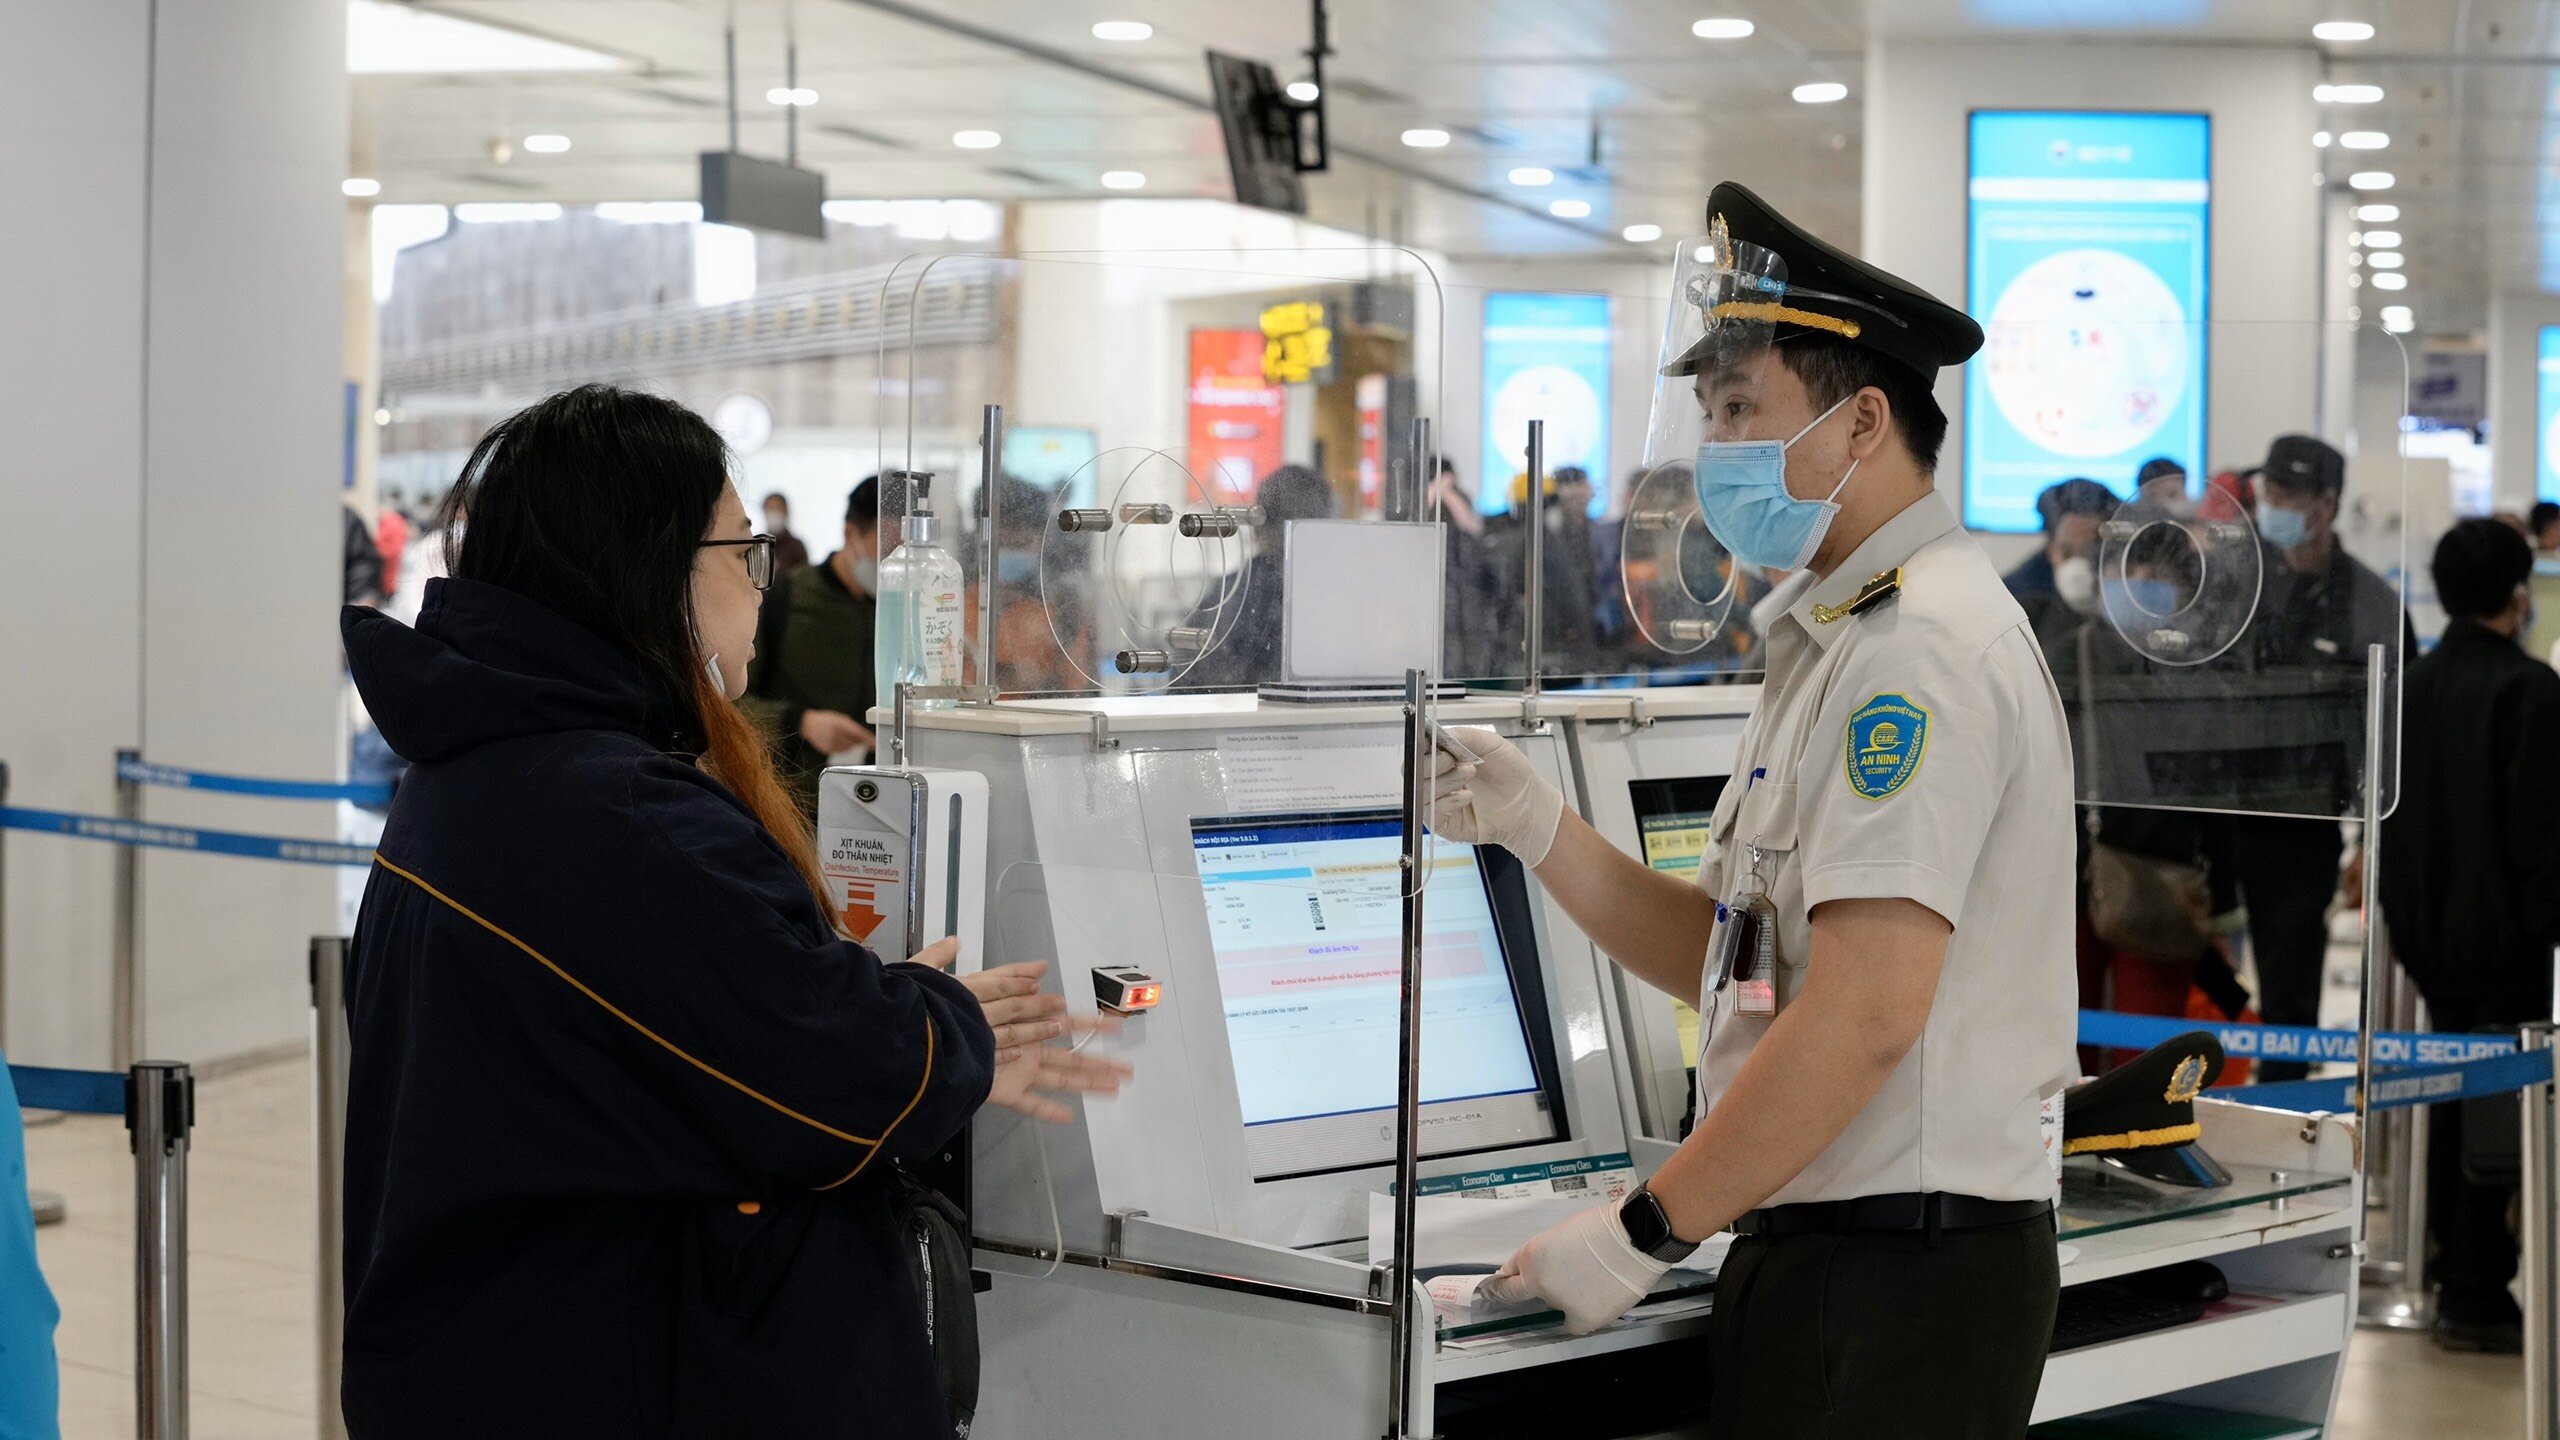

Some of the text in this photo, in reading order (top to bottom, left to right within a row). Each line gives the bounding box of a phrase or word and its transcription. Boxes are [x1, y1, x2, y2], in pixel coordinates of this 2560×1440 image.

[925, 619, 953, 635] かぞく
[1860, 754, 1900, 766] AN NINH
[1865, 767, 1892, 775] SECURITY
[841, 838, 853, 849] XỊT
[832, 850, 893, 865] ĐO THÂN NHIỆT
[825, 862, 899, 876] Disinfection, Temperature
[2219, 1029, 2257, 1052] NOI
[2261, 1032, 2298, 1054] BAI
[2305, 1035, 2411, 1062] AVIAION
[1549, 1162, 1576, 1175] Economy
[1576, 1160, 1592, 1171] Class
[1461, 1172, 1506, 1187] Economy Class
